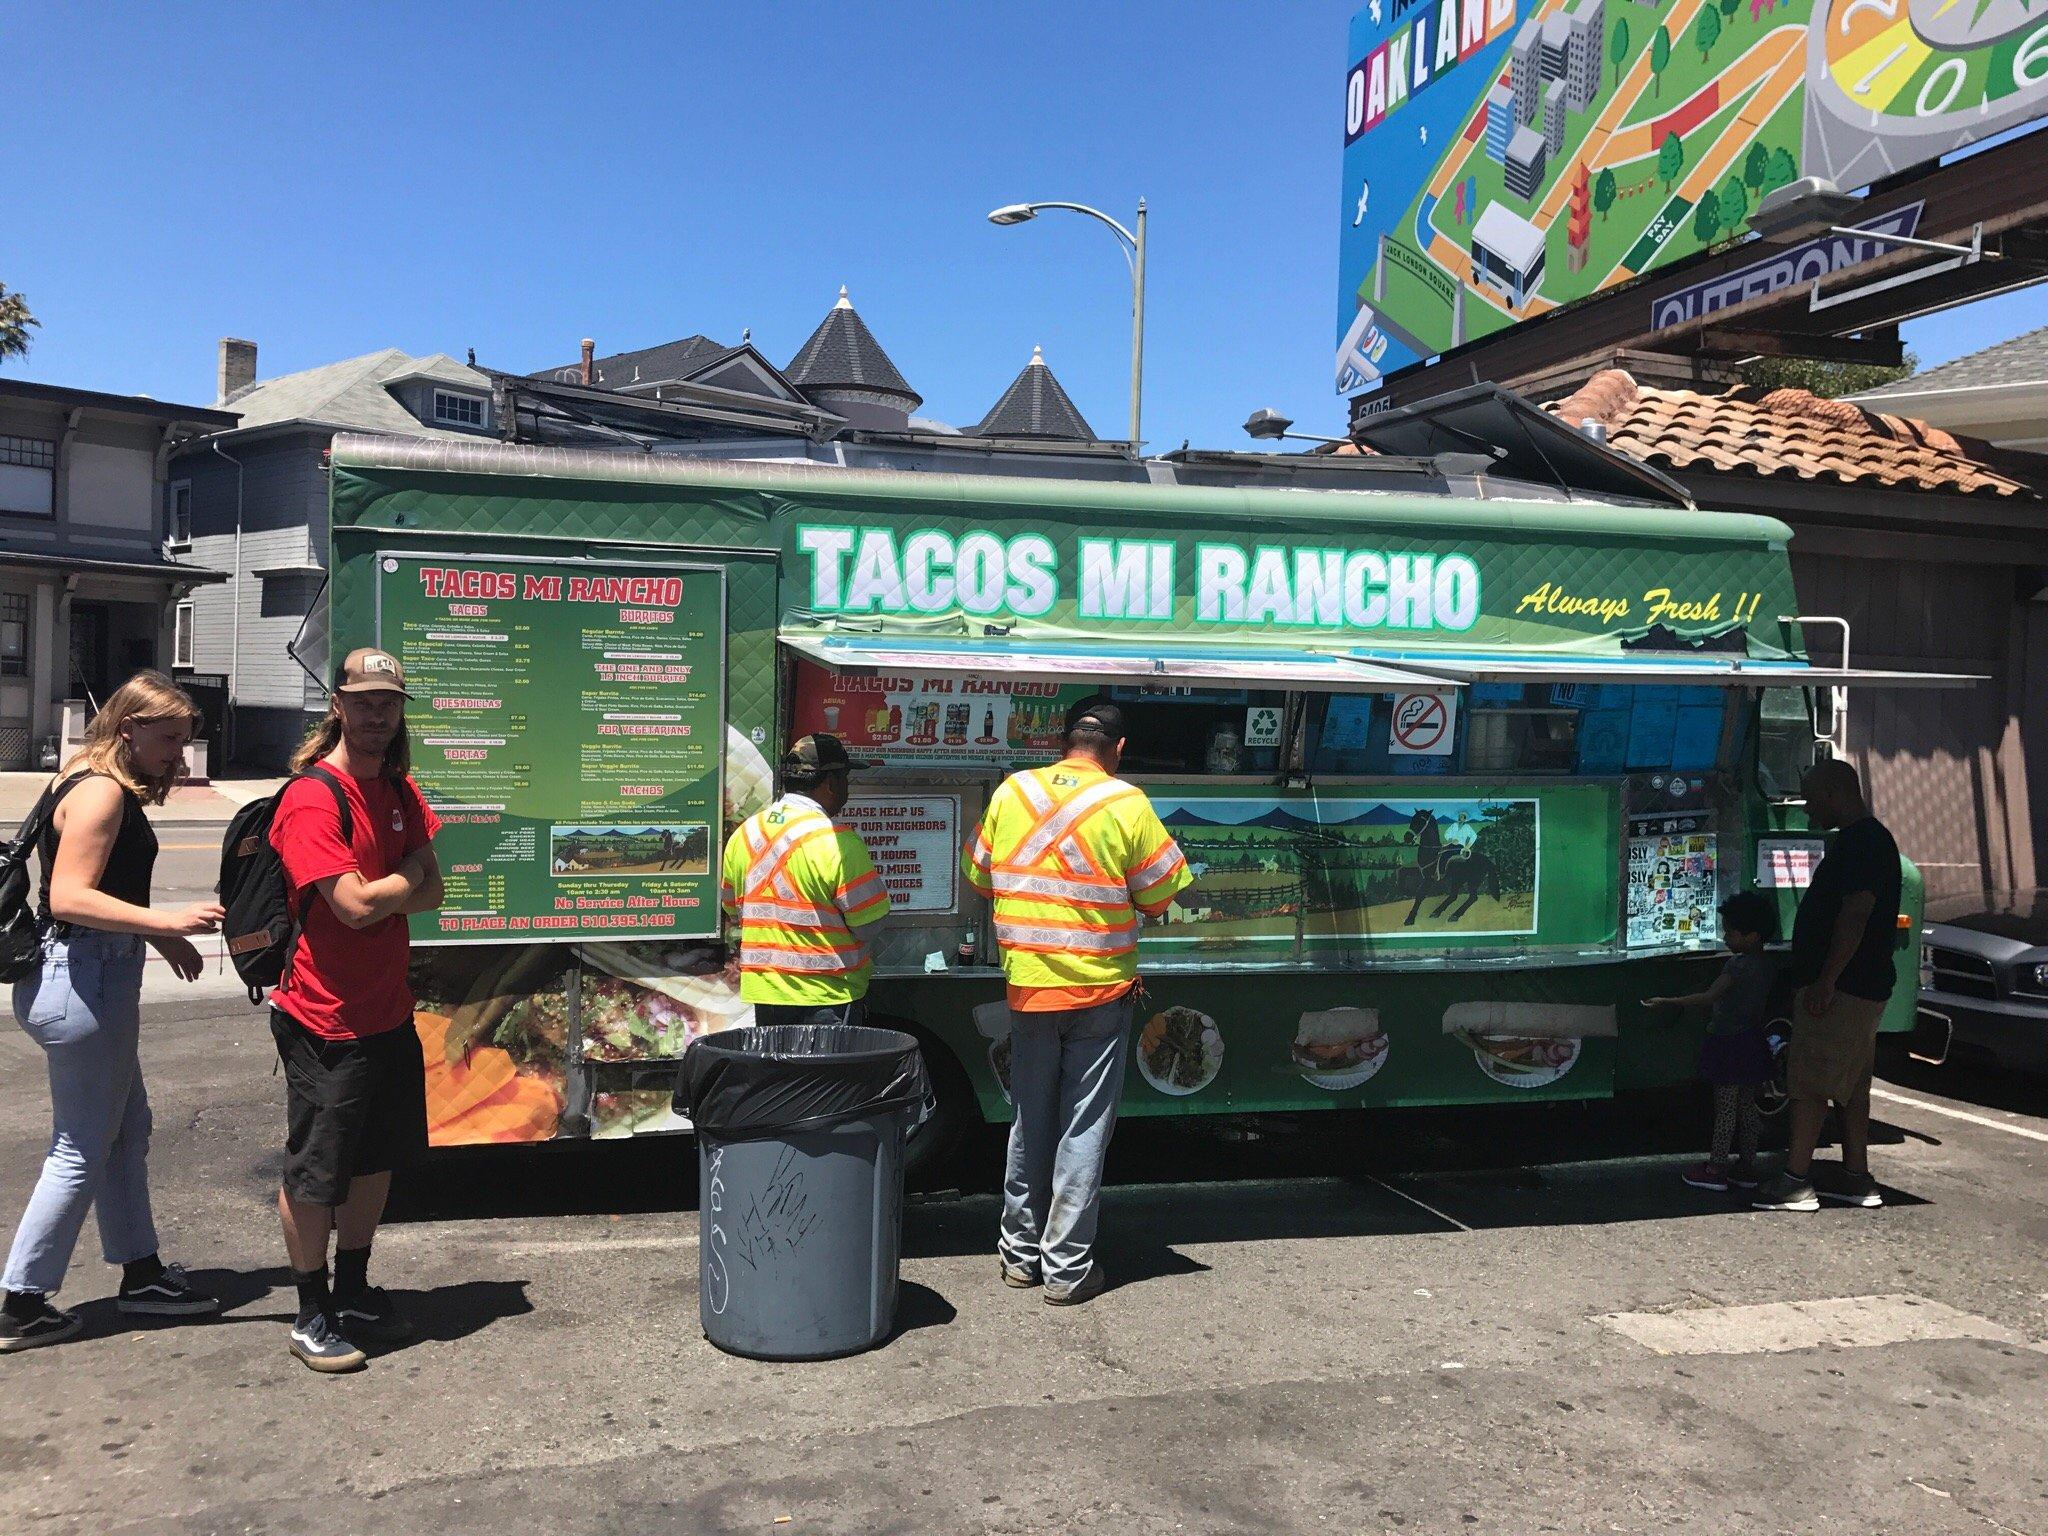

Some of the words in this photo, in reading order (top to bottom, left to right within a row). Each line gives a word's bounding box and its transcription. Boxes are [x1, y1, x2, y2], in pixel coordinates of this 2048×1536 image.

[1646, 214, 1667, 239] PAY
[1654, 220, 1675, 244] DAY
[1387, 245, 1401, 259] JACK
[1403, 254, 1427, 276] LONDON
[1429, 272, 1455, 302] SQUARE
[797, 524, 1059, 617] TACOS
[1078, 536, 1176, 621] MI
[1195, 541, 1482, 632] RANCHO
[420, 568, 516, 600] TACOS
[523, 575, 562, 600] MI
[568, 577, 683, 606] RANCHO
[1516, 582, 1631, 624] Always
[1643, 588, 1721, 624] Fresh
[1732, 592, 1762, 623] !!
[449, 604, 488, 616] TACOS
[620, 609, 675, 624] BURRITOS
[594, 664, 616, 672] THE
[618, 664, 640, 673] ONE
[640, 664, 664, 673] AND
[665, 665, 693, 674] ONLY
[615, 673, 641, 682] INCH
[642, 674, 687, 683] BURRITO
[433, 698, 502, 710] QUESADILLAS
[597, 725, 621, 735] FOR
[621, 725, 691, 736] VEGETARIANS
[444, 749, 489, 760] TORTAS
[620, 786, 664, 796] NACHOS
[880, 807, 908, 816] HELP
[911, 807, 924, 816] US
[861, 822, 882, 831] OUR
[886, 821, 947, 831] NEIGHBORS
[864, 836, 899, 846] HAPPY
[881, 851, 917, 860] HOURS
[887, 864, 921, 874] MUSIC
[885, 879, 923, 889] VOICES
[555, 897, 574, 910] No
[577, 897, 624, 909] Service
[626, 896, 659, 908] After
[662, 895, 700, 907] Hours
[890, 893, 910, 903] YOU
[439, 918, 459, 931] TO
[462, 917, 506, 931] PLACE
[509, 917, 530, 929] AN
[533, 916, 579, 928] ORDER
[582, 914, 675, 928] 510.395.1403
